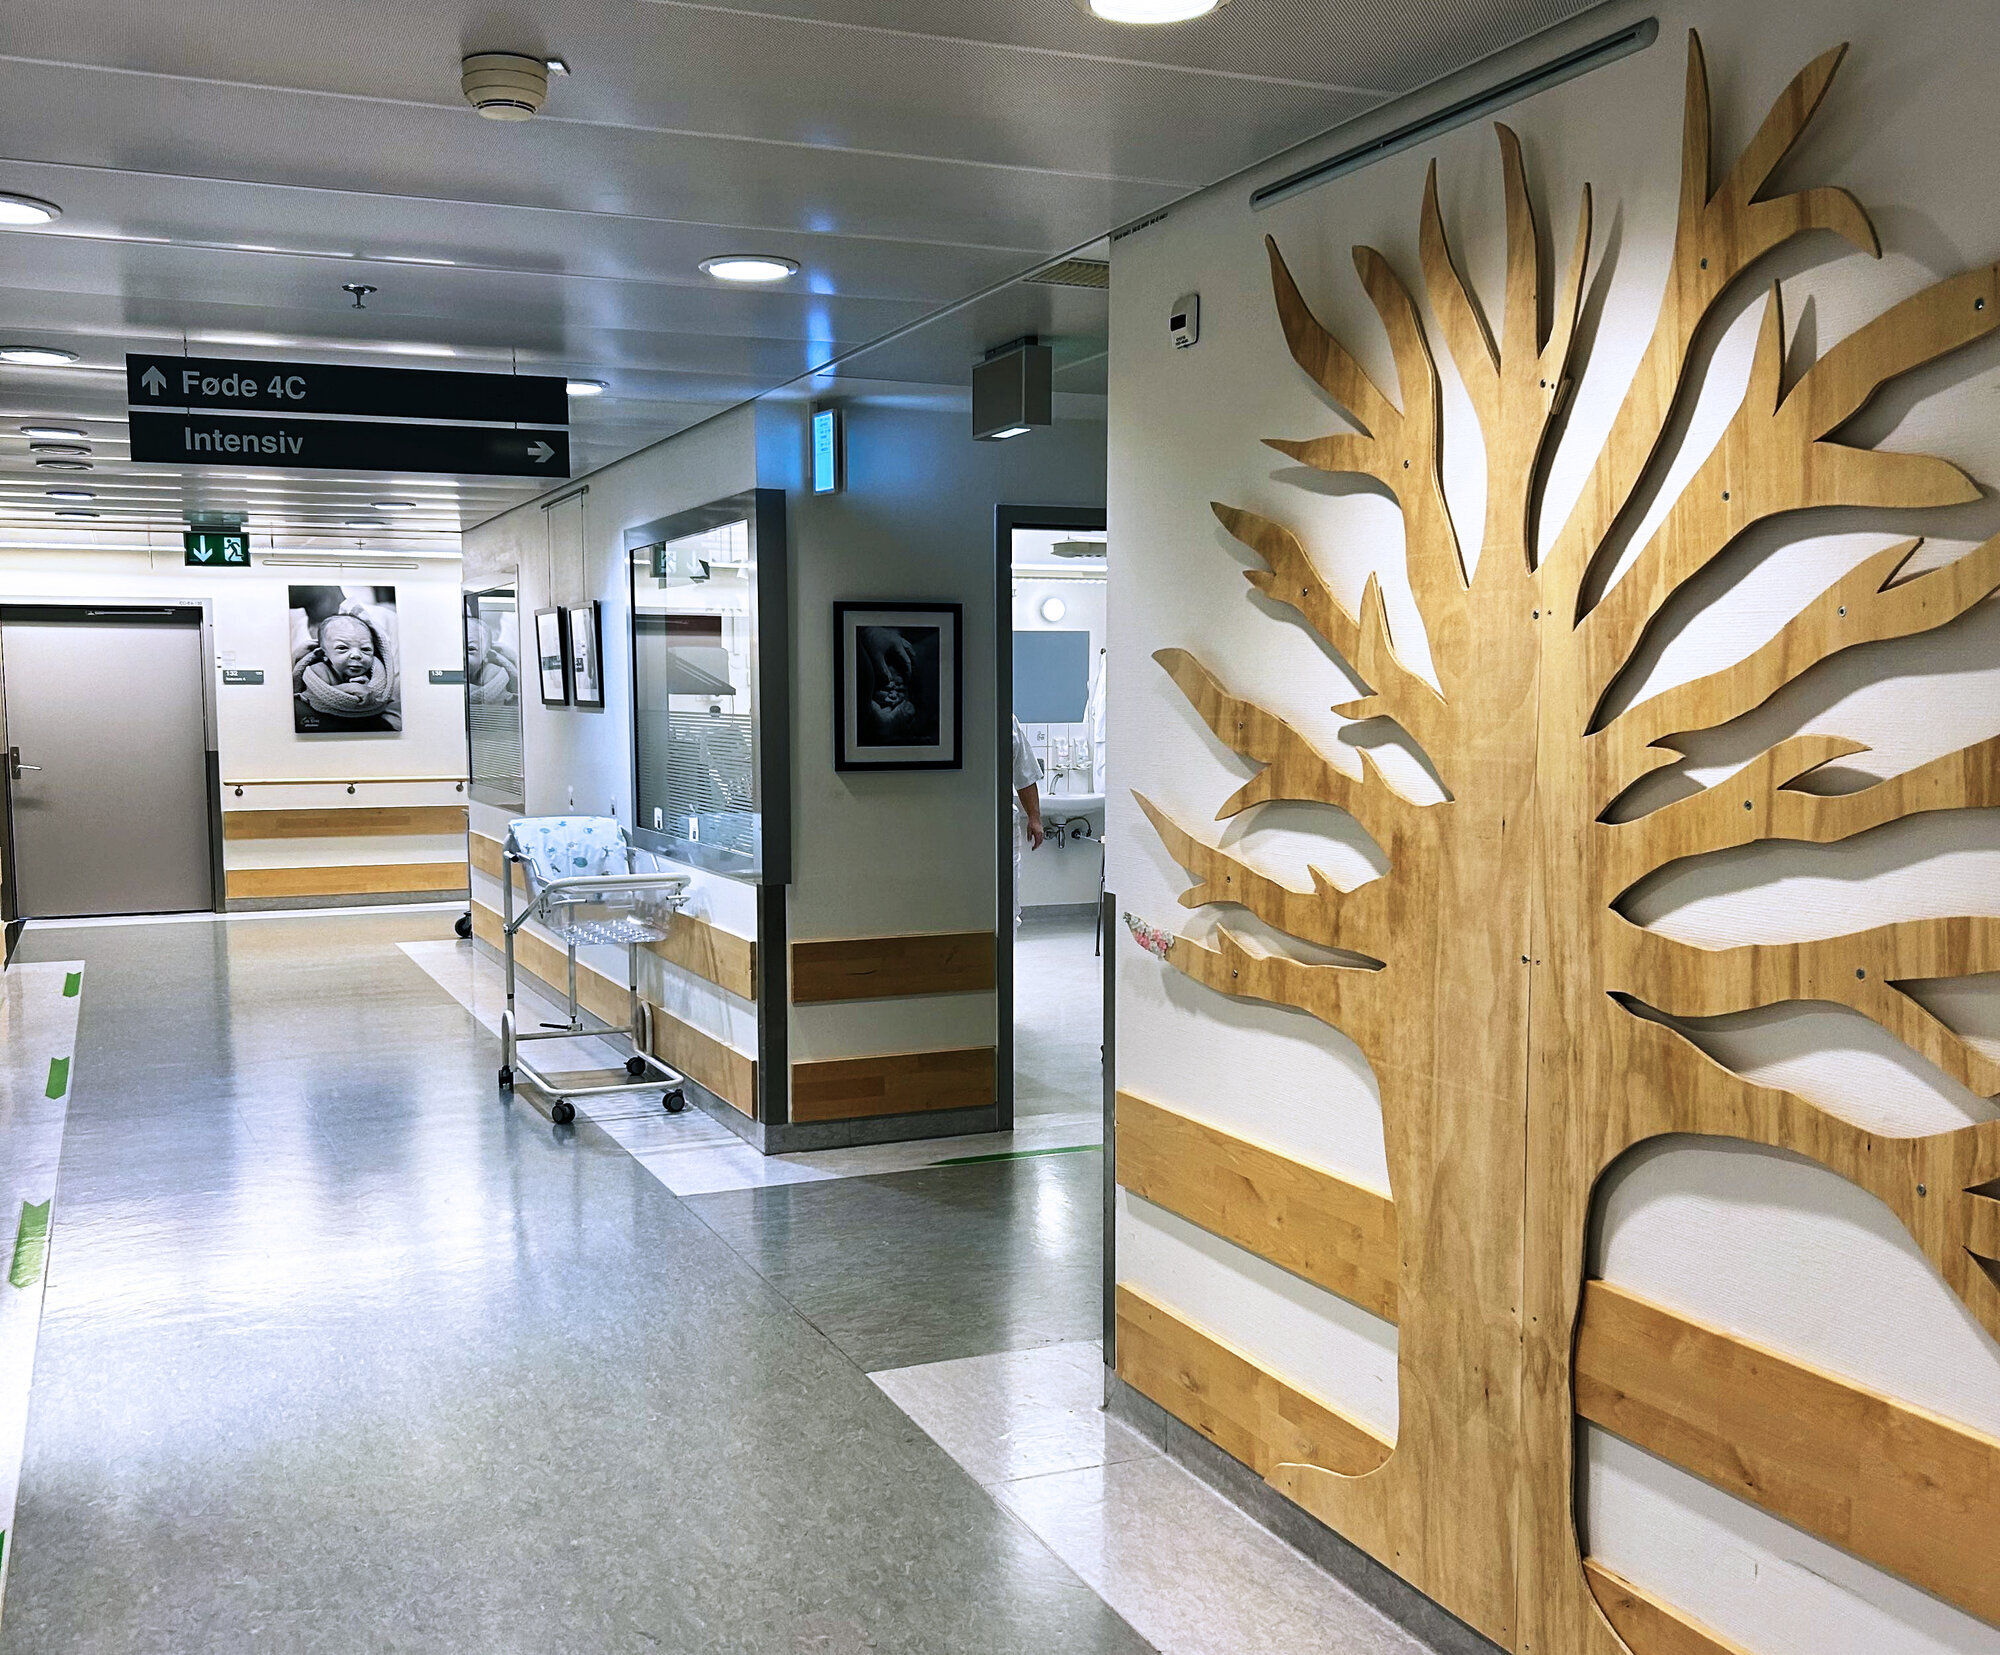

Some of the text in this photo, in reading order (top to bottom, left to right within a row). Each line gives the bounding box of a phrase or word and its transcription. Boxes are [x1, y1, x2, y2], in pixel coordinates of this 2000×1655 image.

[182, 369, 307, 400] Føde 4C
[185, 426, 304, 455] Intensiv
